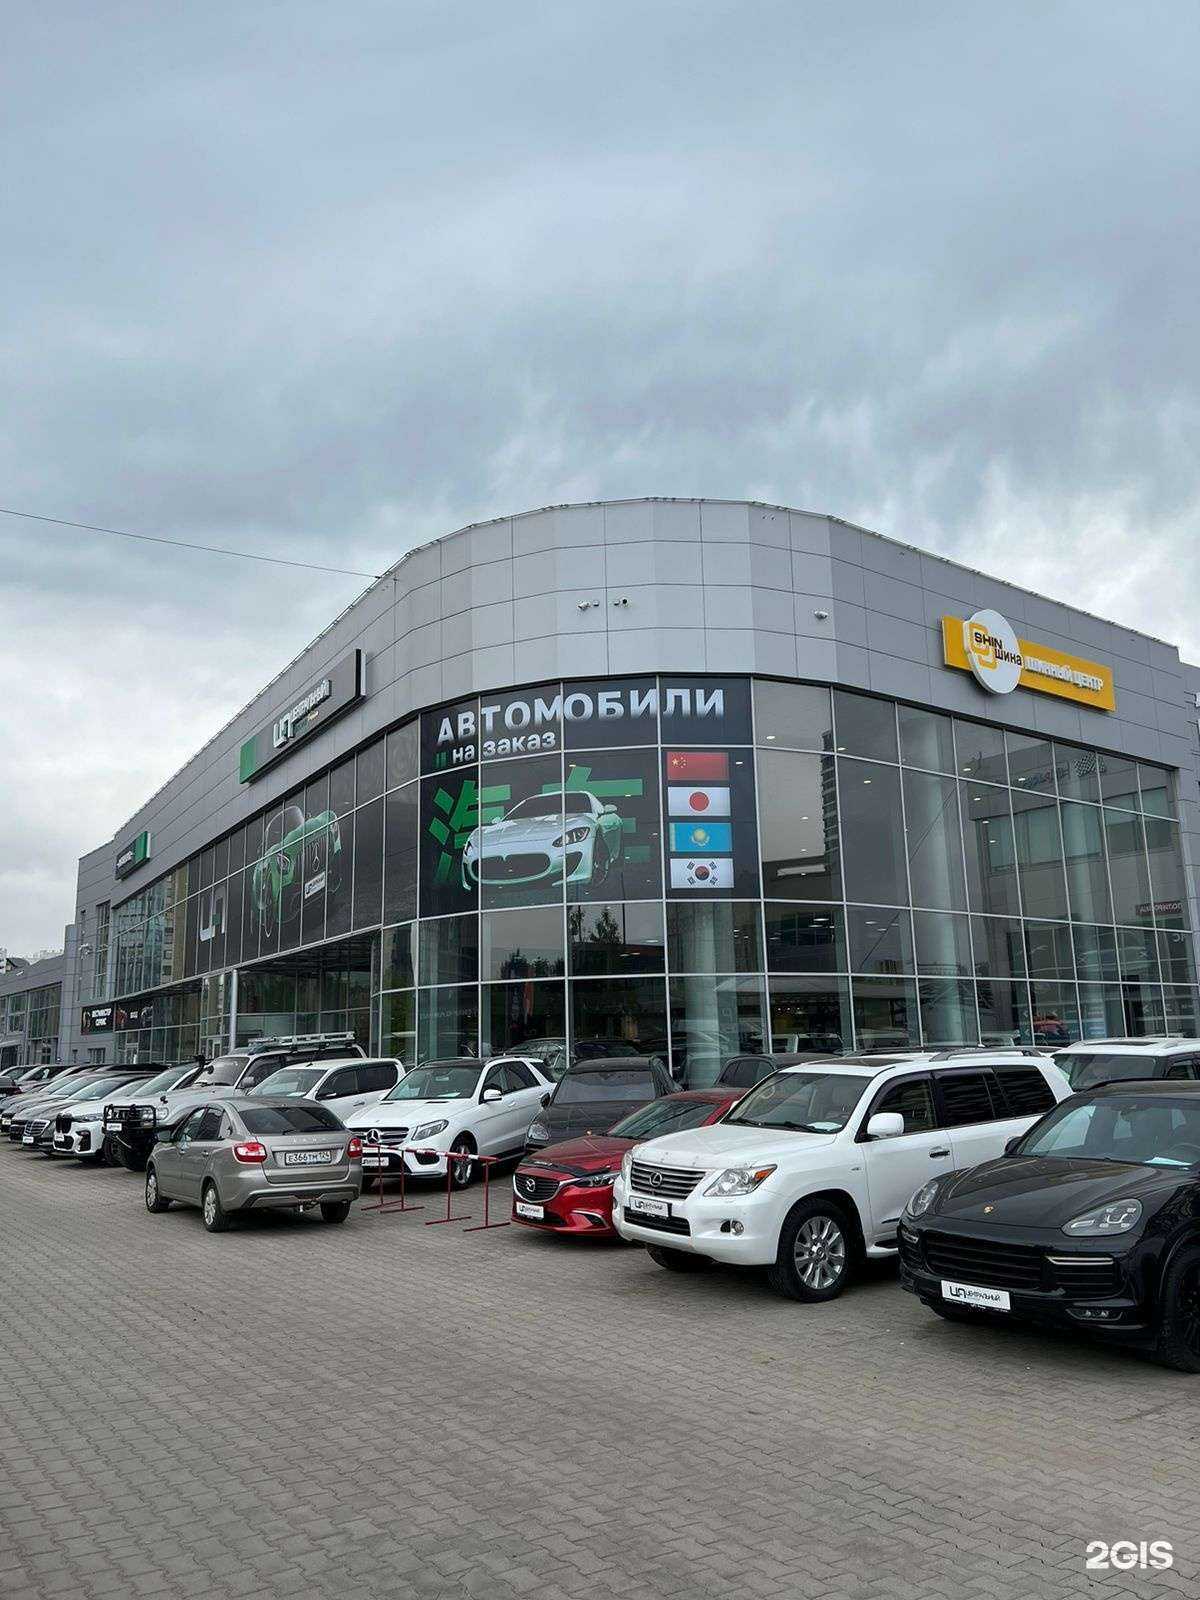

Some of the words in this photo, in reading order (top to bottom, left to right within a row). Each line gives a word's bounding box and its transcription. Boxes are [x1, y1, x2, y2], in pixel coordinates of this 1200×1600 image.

[974, 632, 1003, 650] SHIN
[436, 688, 724, 745] АВТОМОБИЛИ
[452, 744, 475, 764] на
[482, 731, 557, 758] заказ
